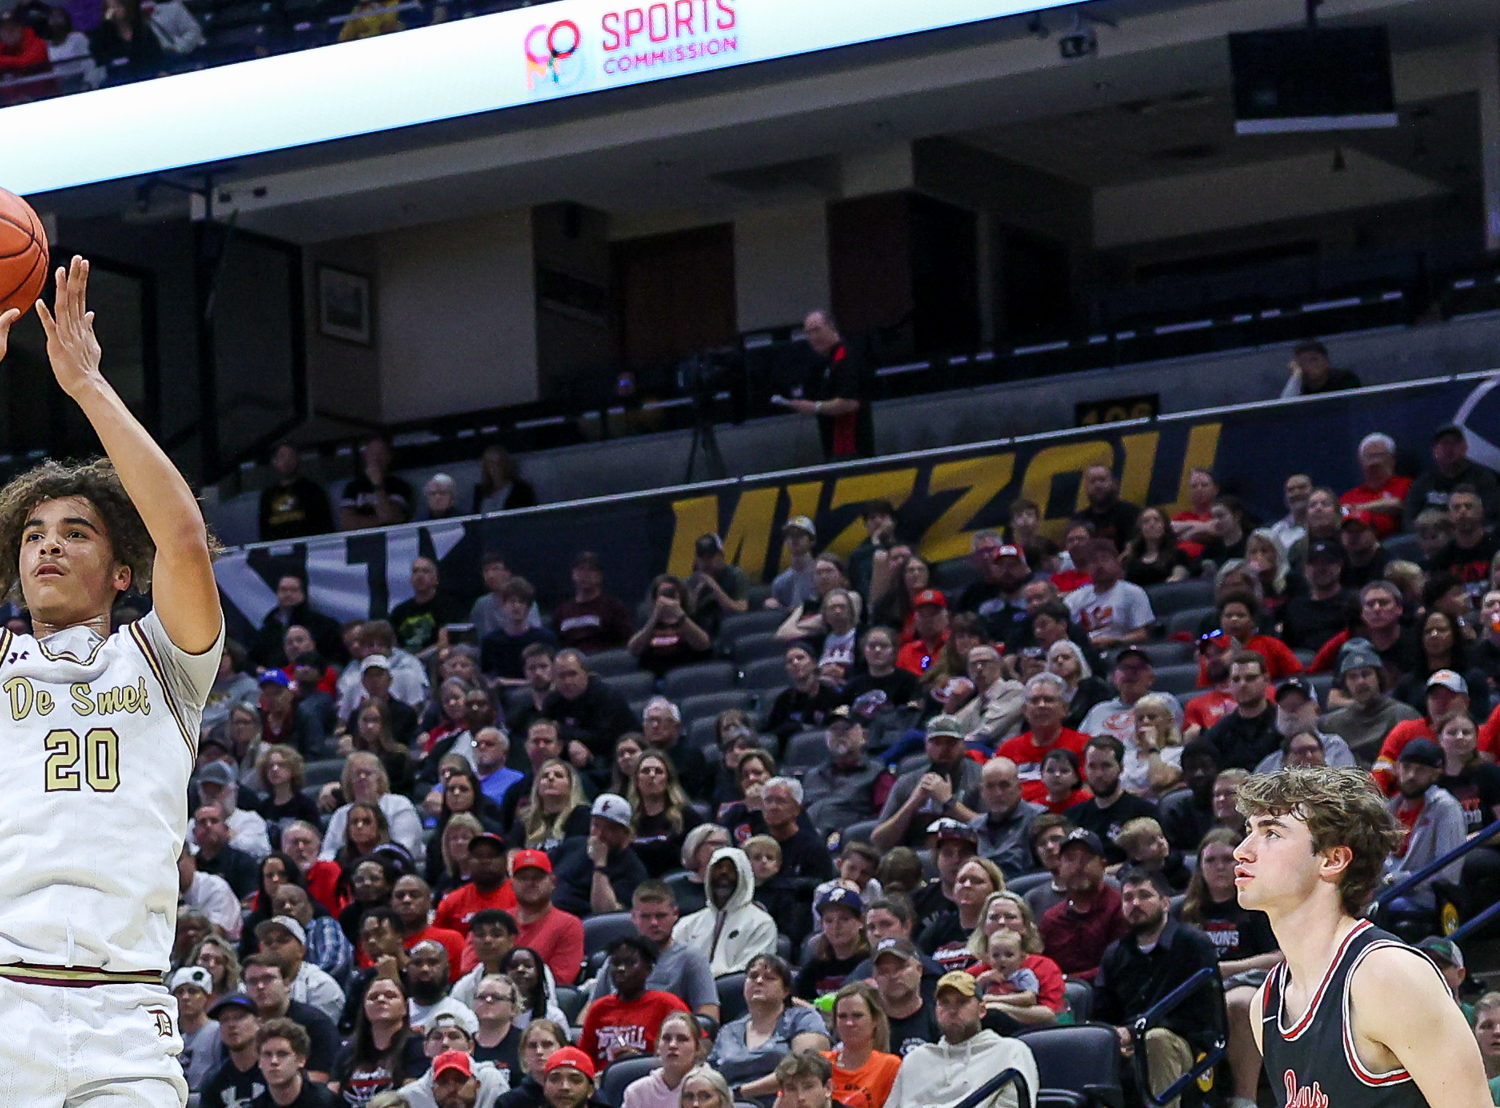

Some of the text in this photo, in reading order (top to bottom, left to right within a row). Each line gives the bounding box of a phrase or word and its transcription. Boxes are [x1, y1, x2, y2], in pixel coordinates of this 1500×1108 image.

[602, 0, 736, 51] SPORTS
[604, 36, 738, 75] COMMISSION
[666, 422, 1223, 584] MIZZOU
[3, 676, 151, 721] De Smet
[44, 727, 120, 792] 20
